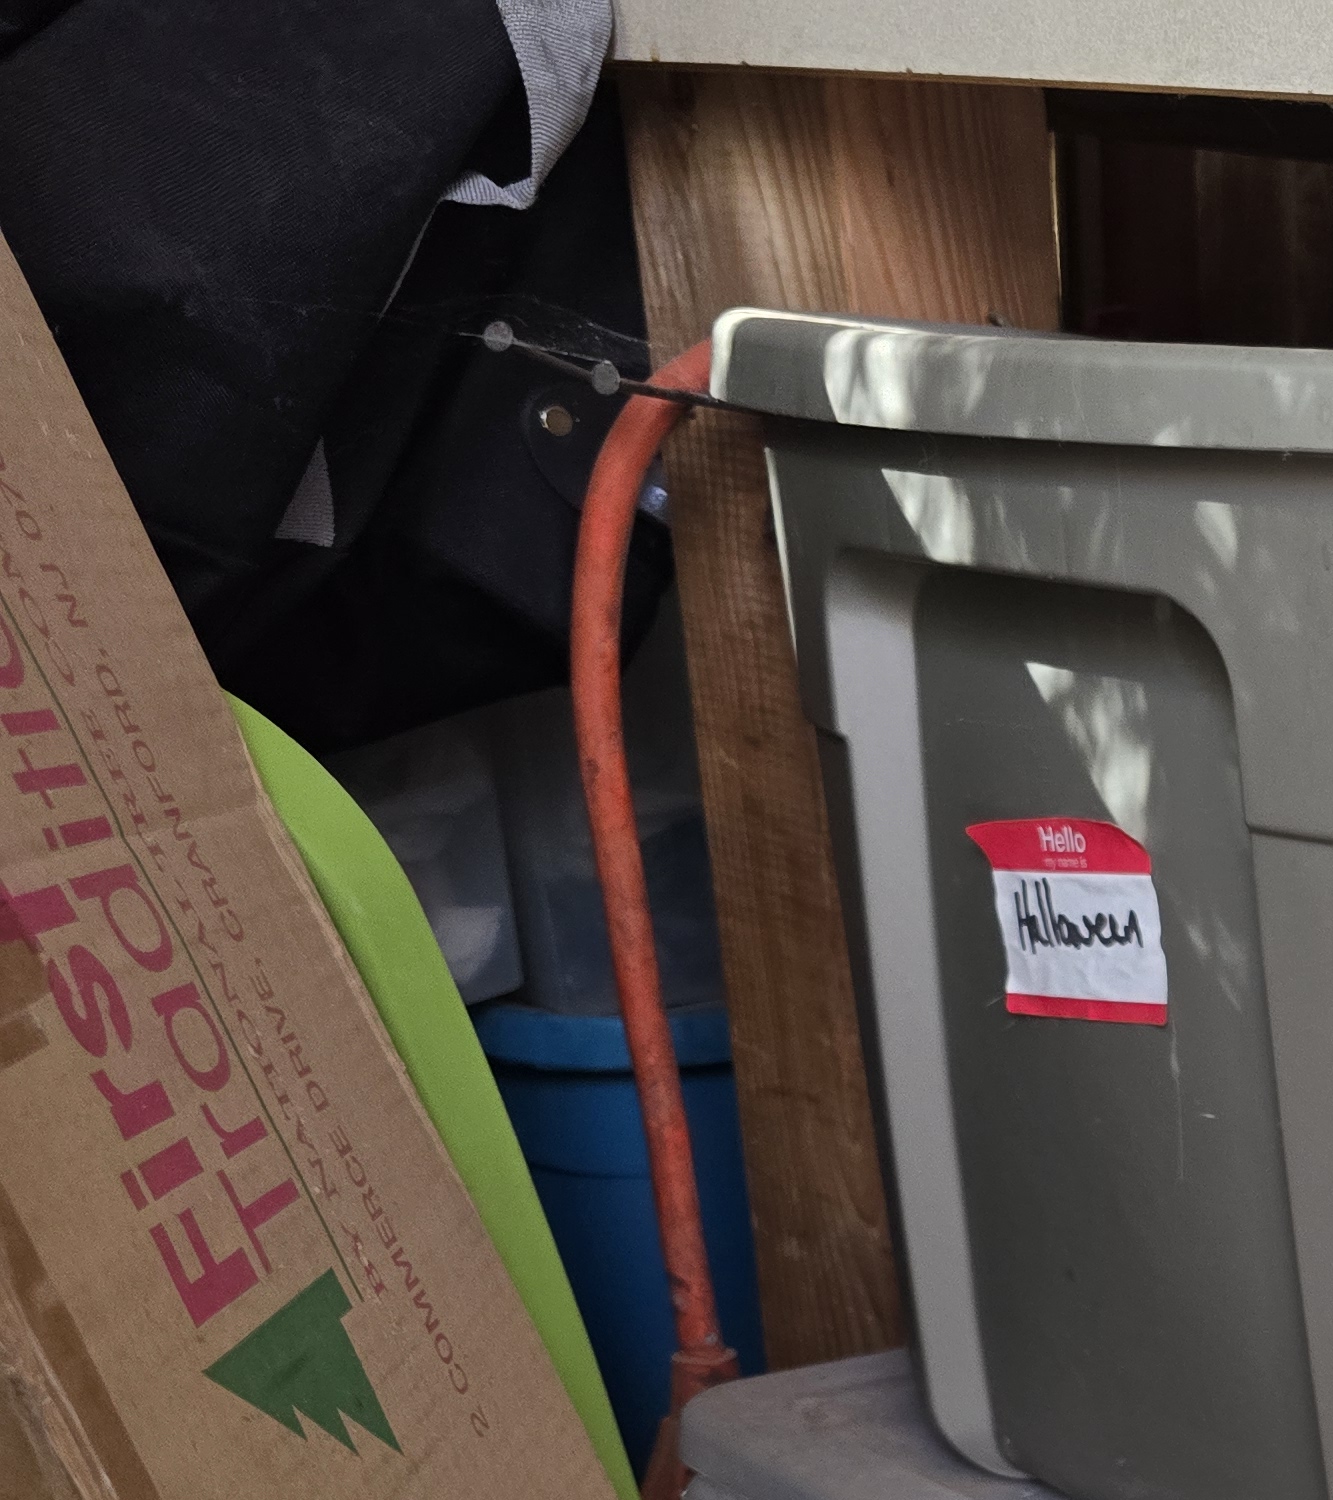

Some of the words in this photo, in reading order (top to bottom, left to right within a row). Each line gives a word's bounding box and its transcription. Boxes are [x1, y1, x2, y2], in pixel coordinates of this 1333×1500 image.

[38, 562, 89, 629] NJ
[80, 707, 165, 874] TREE
[94, 646, 245, 944] CRANFORD,
[1037, 824, 1087, 854] Hello
[1014, 877, 1144, 955] Halloween
[0, 877, 259, 1328] First
[173, 876, 338, 1199] NATIONAL
[252, 956, 330, 1112] DRIVE,
[328, 1123, 470, 1396] COMMERCE
[470, 1404, 490, 1438] 2
